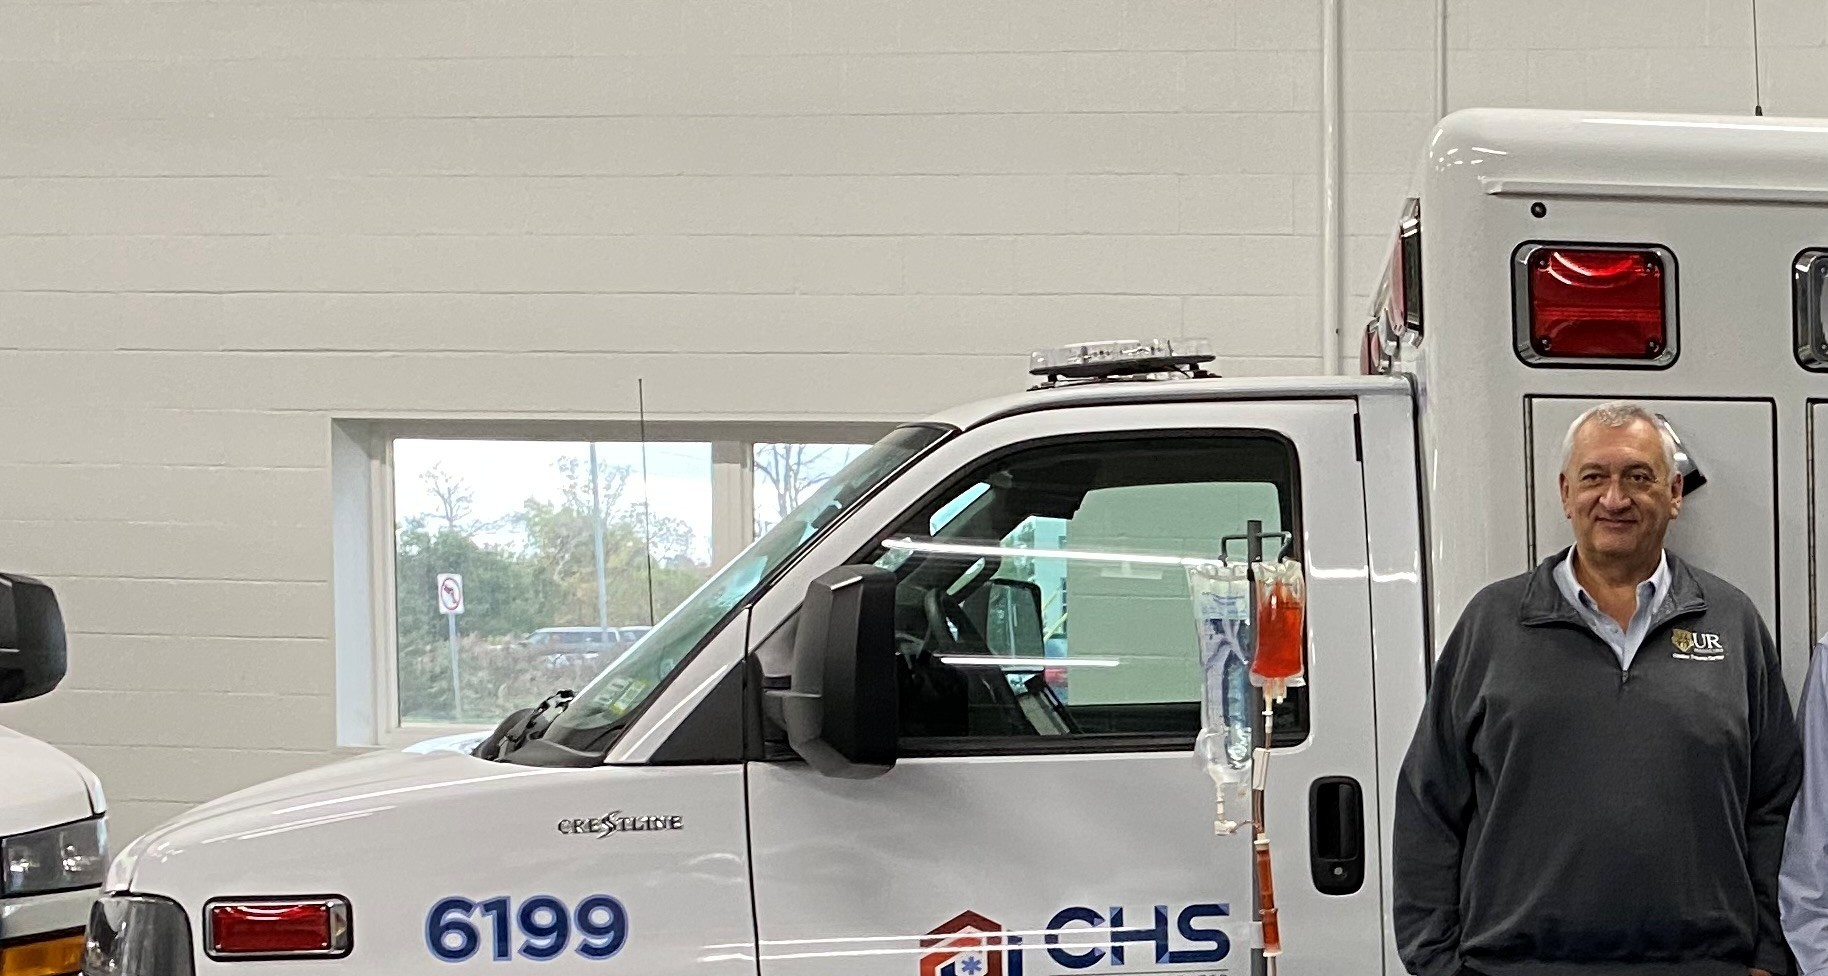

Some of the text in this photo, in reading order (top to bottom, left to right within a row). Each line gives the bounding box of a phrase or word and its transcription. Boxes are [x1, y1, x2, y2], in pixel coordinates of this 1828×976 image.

[1693, 632, 1723, 649] UR
[557, 809, 684, 839] CRESTLINE
[425, 893, 629, 963] 6199
[1044, 903, 1231, 969] CHS
